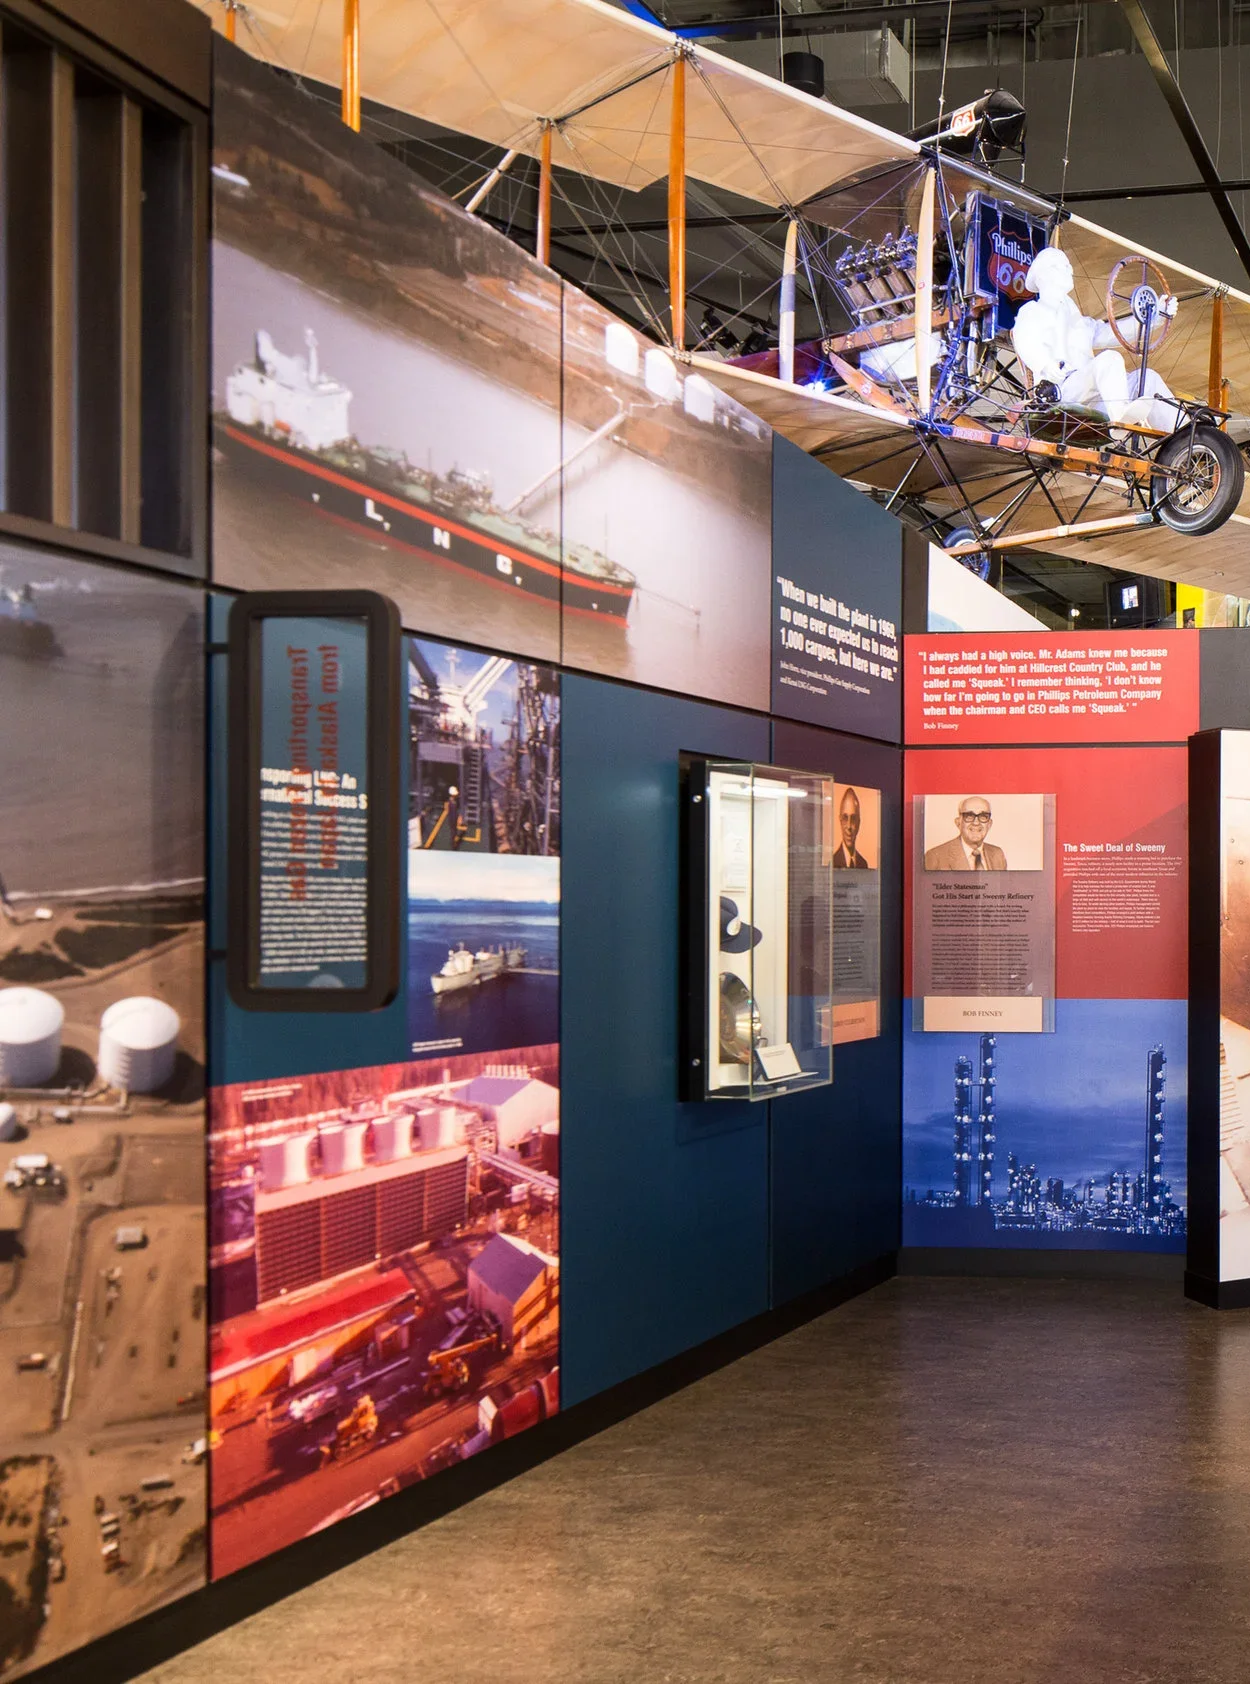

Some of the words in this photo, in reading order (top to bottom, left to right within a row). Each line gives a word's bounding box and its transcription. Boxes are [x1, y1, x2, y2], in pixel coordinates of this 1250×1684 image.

[954, 109, 973, 130] 66
[991, 232, 1032, 266] Phillips
[998, 262, 1027, 294] 66
[837, 601, 850, 622] the
[869, 614, 877, 633] in
[780, 606, 792, 623] no
[792, 610, 809, 629] one
[809, 617, 828, 636] ever
[828, 624, 861, 648] expected
[861, 636, 871, 652] us
[871, 637, 879, 655] to
[879, 643, 899, 662] reach
[780, 627, 804, 651] 1,000
[805, 639, 838, 665] cargoes,
[838, 647, 852, 668] but
[852, 652, 869, 673] here
[869, 660, 880, 677] we
[928, 651, 959, 663] always
[961, 650, 978, 661] had
[980, 652, 987, 661] a
[988, 649, 1008, 662] high
[1010, 649, 1037, 660] voice.
[1039, 648, 1054, 659] Mr.
[1055, 648, 1086, 659] Adams
[1088, 648, 1112, 658] knew
[1113, 649, 1128, 658] me
[1130, 647, 1168, 658] because
[923, 665, 927, 675] I
[929, 664, 946, 675] had
[947, 664, 982, 675] caddied
[984, 663, 997, 674] for
[999, 663, 1016, 674] him
[1018, 663, 1028, 673] at
[1030, 662, 1067, 673] Hillcrest
[1069, 662, 1104, 674] Country
[1106, 661, 1129, 673] Club,
[1130, 661, 1148, 671] and
[1150, 660, 1162, 671] he
[923, 678, 950, 689] called
[952, 679, 966, 688] me
[1017, 676, 1063, 687] remember
[1065, 676, 1103, 688] thinking,
[1113, 675, 1137, 686] don't
[1138, 675, 1162, 685] know
[923, 692, 942, 702] how
[944, 691, 956, 702] far
[959, 691, 973, 702] I'm
[975, 691, 1000, 703] going
[1002, 691, 1011, 701] to
[1013, 691, 1025, 703] go
[1027, 690, 1035, 700] in
[1038, 689, 1071, 702] Phillips
[1072, 689, 1118, 700] Petroleum
[1120, 688, 1162, 701] Company
[923, 706, 947, 716] when
[949, 705, 963, 716] the
[965, 704, 1007, 716] chairman
[1009, 704, 1025, 714] and
[1027, 704, 1046, 714] CEO
[1048, 703, 1070, 714] calls
[1072, 705, 1086, 714] me
[923, 722, 936, 730] Bob
[938, 722, 959, 731] Finney
[1063, 843, 1078, 852] The
[1080, 843, 1104, 852] Sweet
[1106, 843, 1124, 852] Deal
[1125, 843, 1134, 852] of
[1135, 843, 1166, 853] Sweeny
[1007, 893, 1034, 901] Refinery
